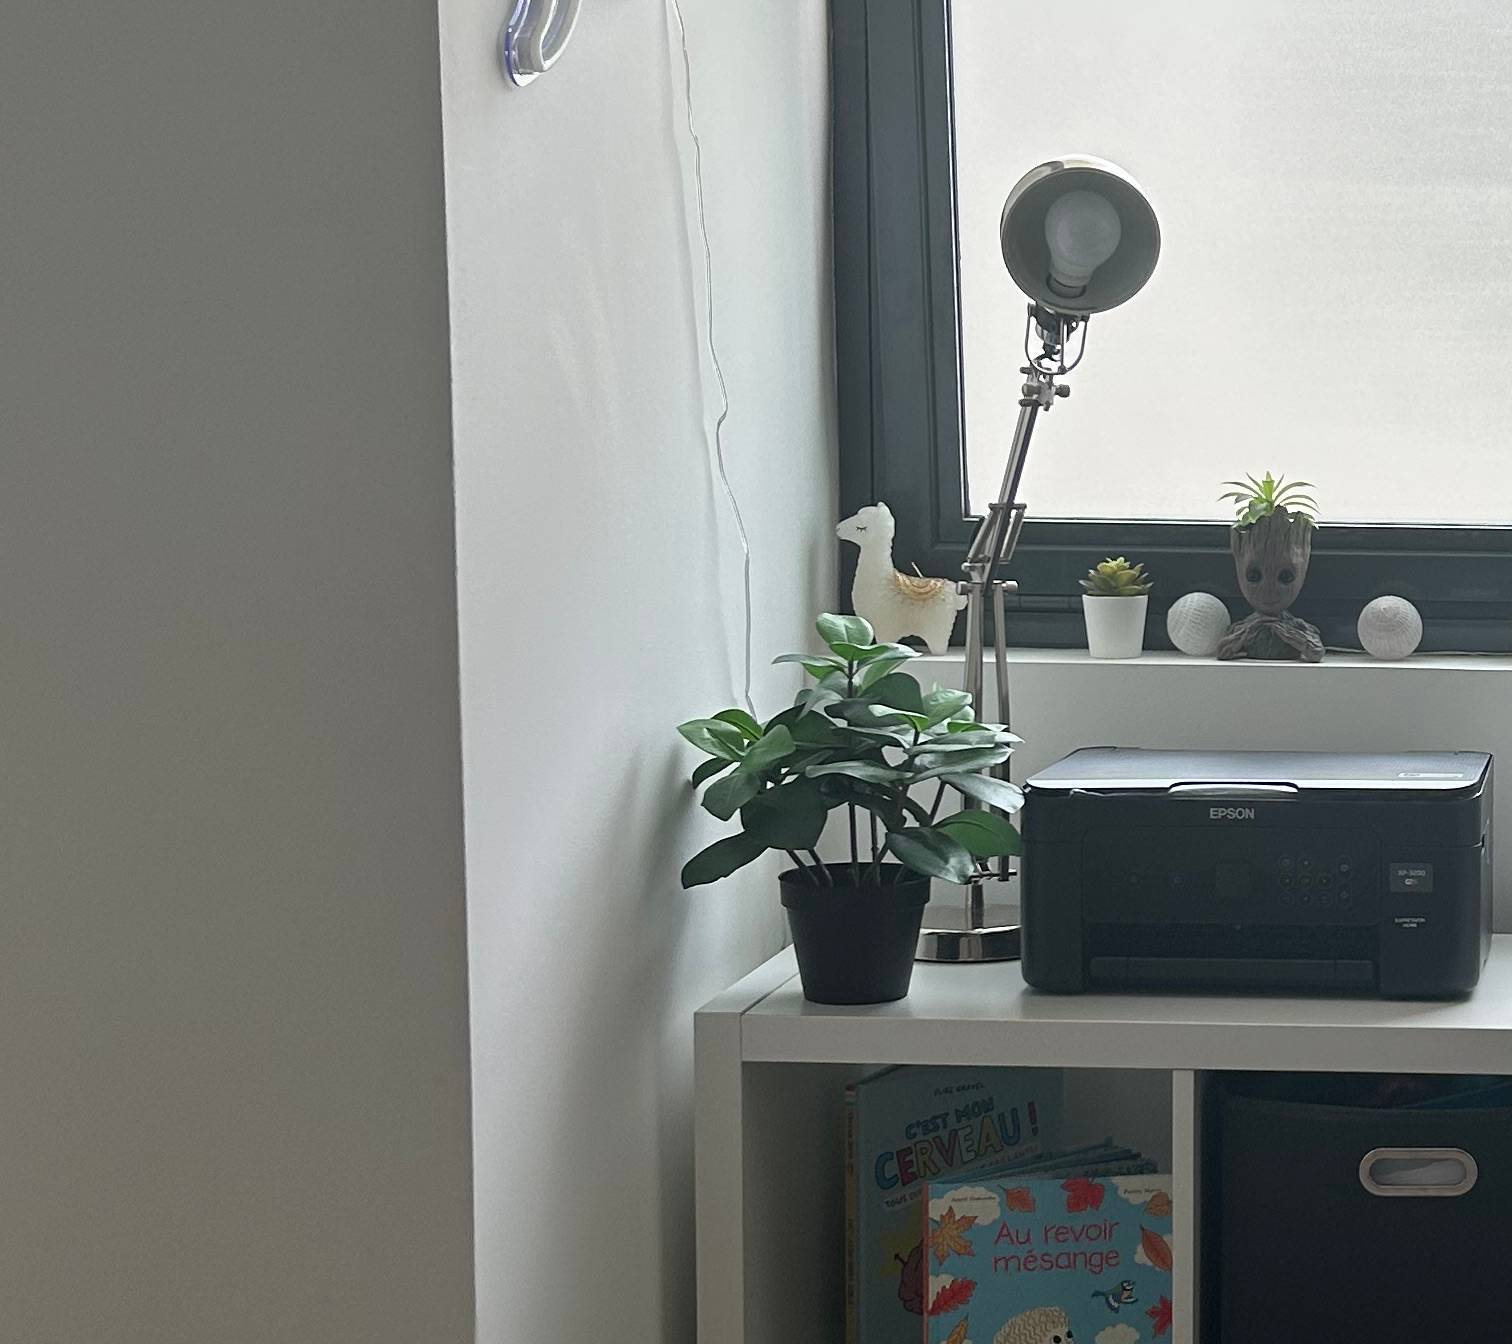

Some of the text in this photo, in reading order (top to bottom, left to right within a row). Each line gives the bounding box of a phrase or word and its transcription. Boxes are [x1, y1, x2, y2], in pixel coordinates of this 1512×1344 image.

[1209, 807, 1255, 820] EPSON
[905, 1096, 996, 1141] C'EST MON
[874, 1107, 1021, 1191] CERVEAU
[993, 1218, 1121, 1246] Au revoir
[991, 1246, 1121, 1275] mésange
